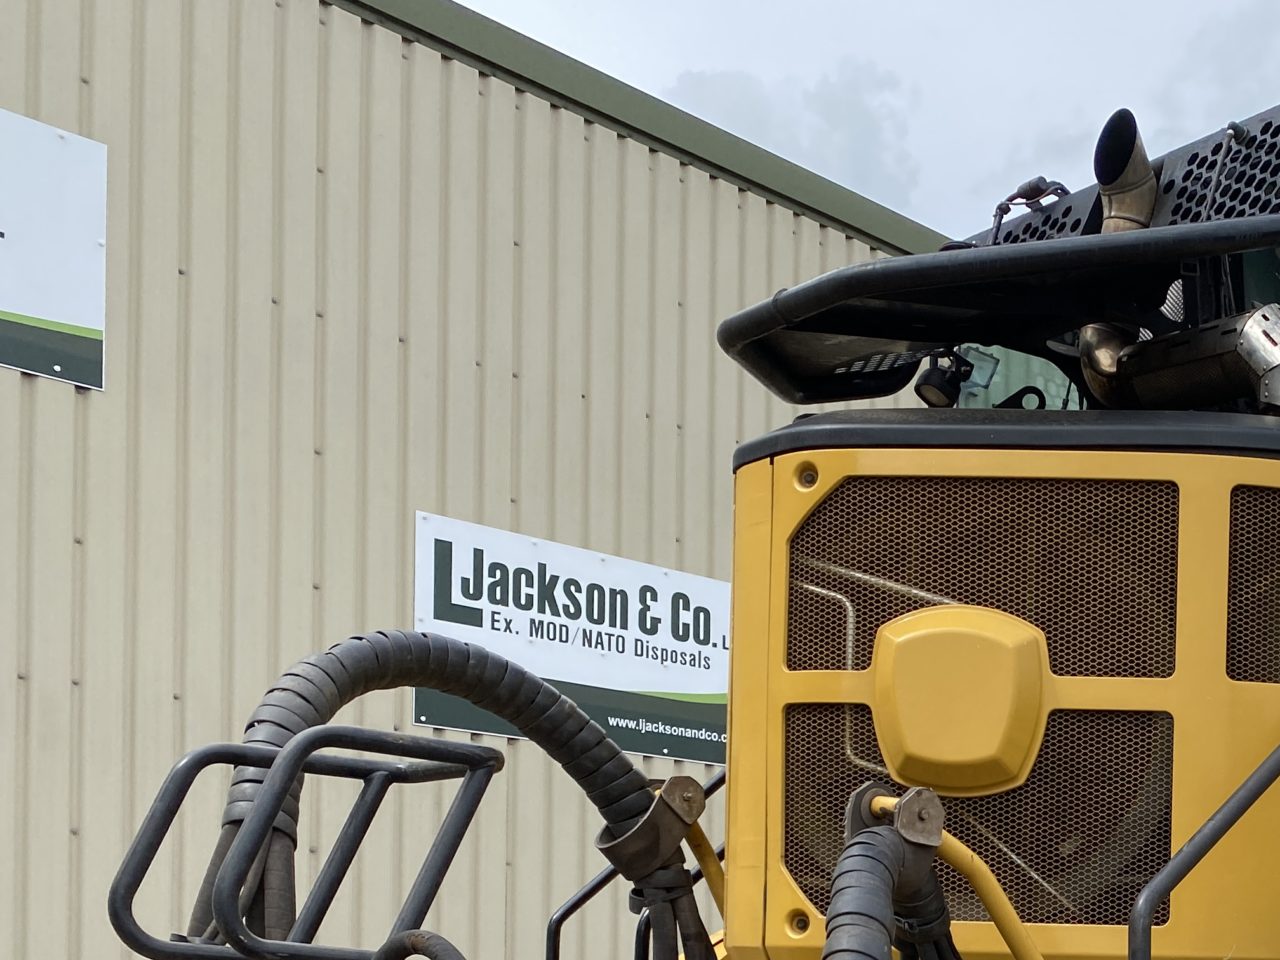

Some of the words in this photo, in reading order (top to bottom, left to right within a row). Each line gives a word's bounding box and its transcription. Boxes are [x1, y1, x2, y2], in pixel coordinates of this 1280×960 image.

[491, 611, 519, 635] Ex.
[634, 638, 711, 670] Disposals
[638, 585, 662, 636] &
[671, 592, 717, 648] Co.
[607, 716, 728, 743] www.ljacksonandco.c
